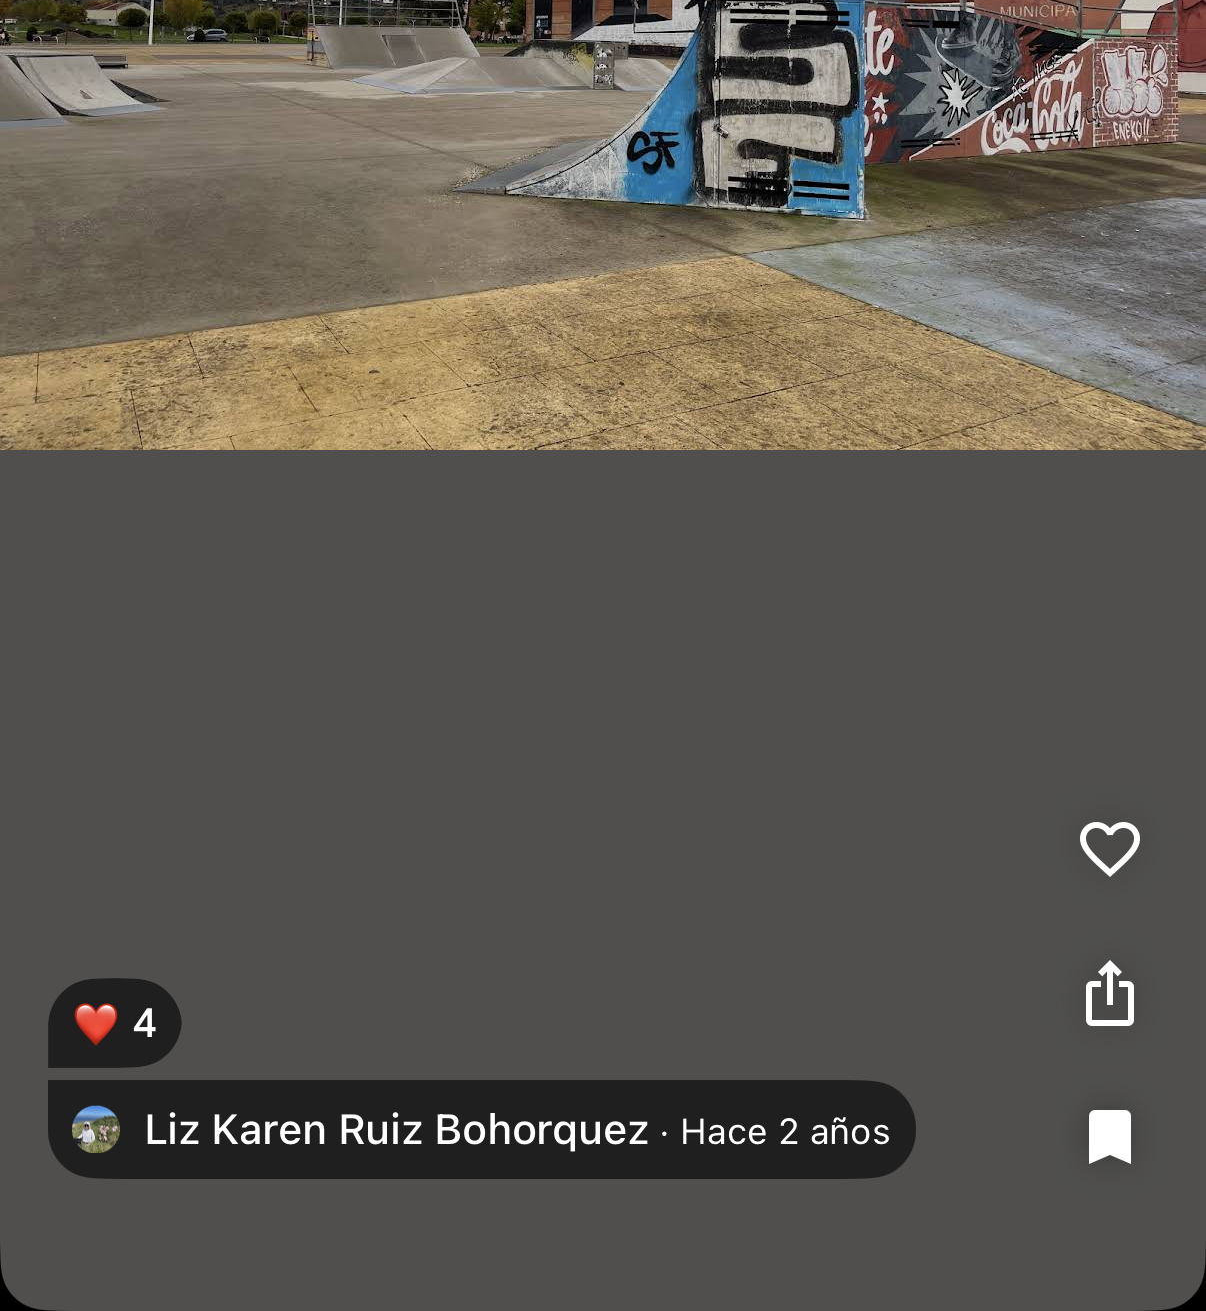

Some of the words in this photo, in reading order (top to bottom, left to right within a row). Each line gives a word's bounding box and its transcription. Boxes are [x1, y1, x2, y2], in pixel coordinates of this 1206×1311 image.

[1000, 4, 1086, 18] MUNICIPA
[864, 9, 895, 77] te
[1113, 118, 1149, 142] ENEKO!!
[627, 131, 679, 175] SF
